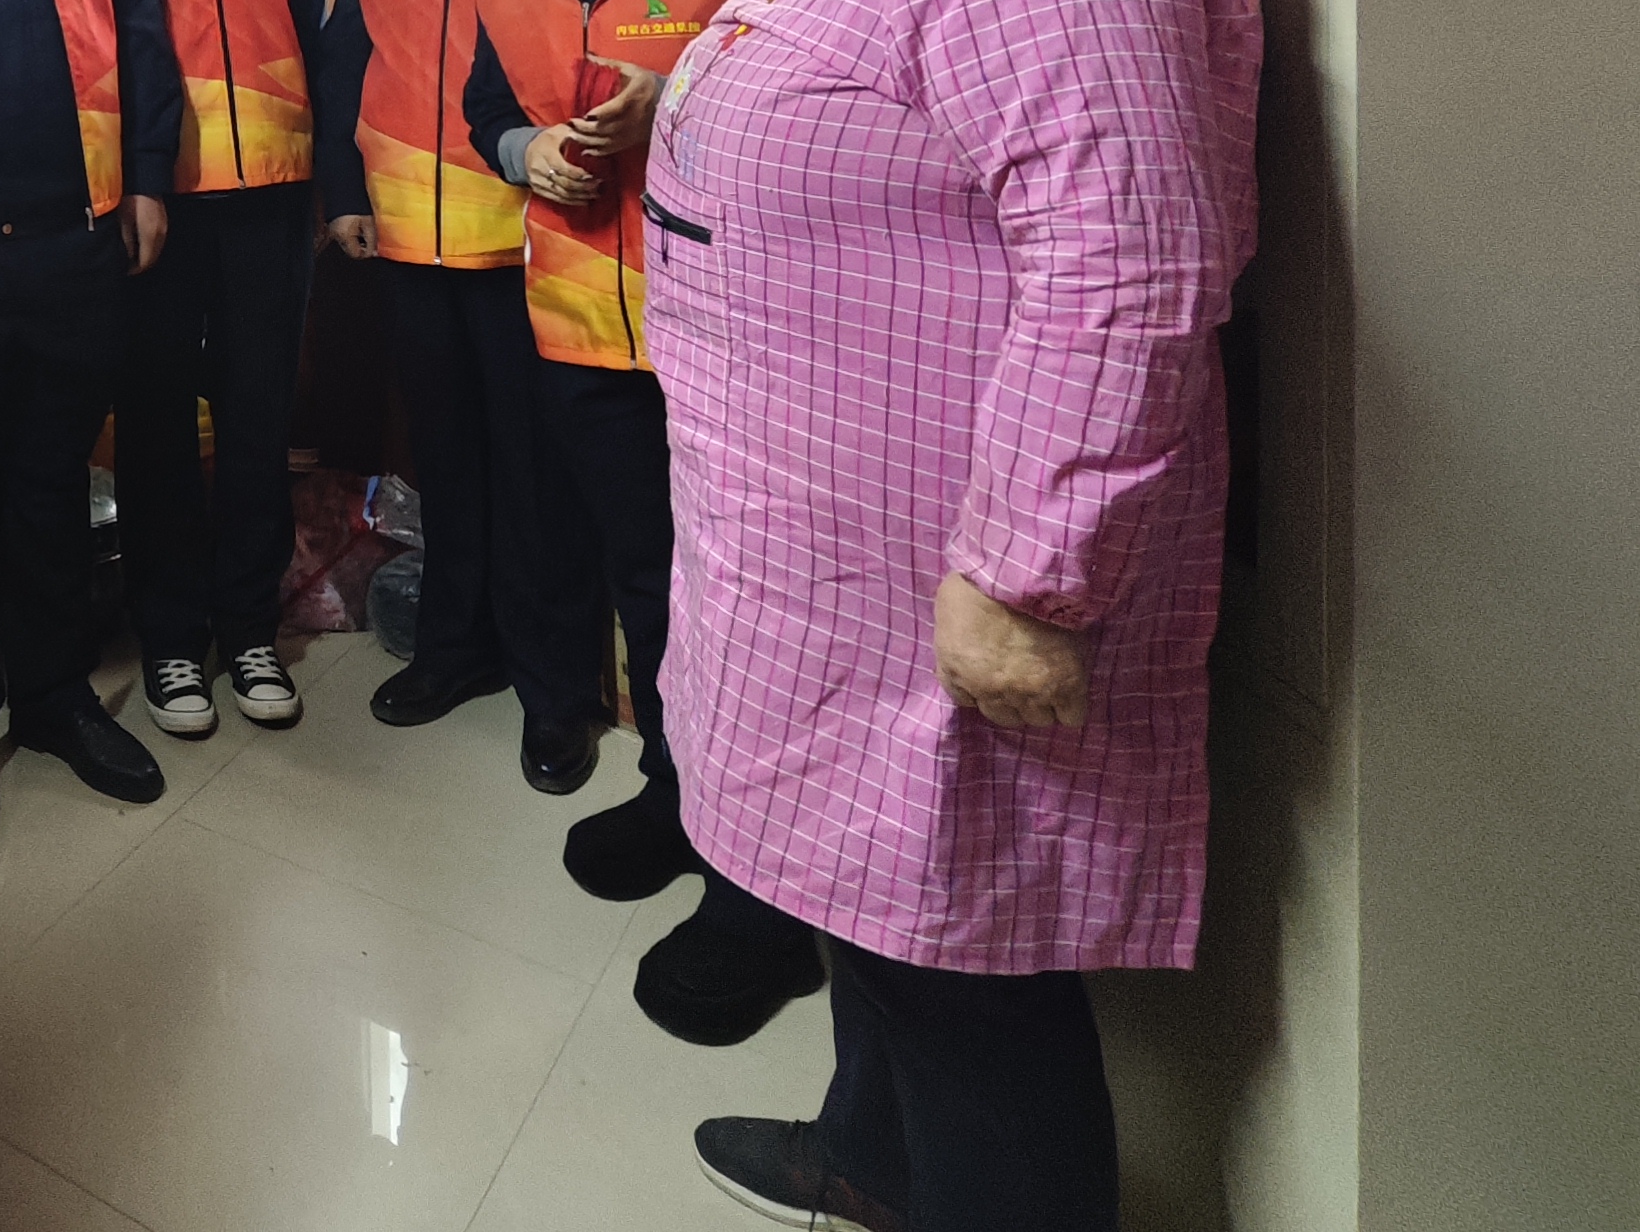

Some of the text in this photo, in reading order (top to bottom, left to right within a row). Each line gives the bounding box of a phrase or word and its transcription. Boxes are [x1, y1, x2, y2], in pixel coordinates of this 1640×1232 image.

[615, 21, 701, 36] 内蒙古交通集团
